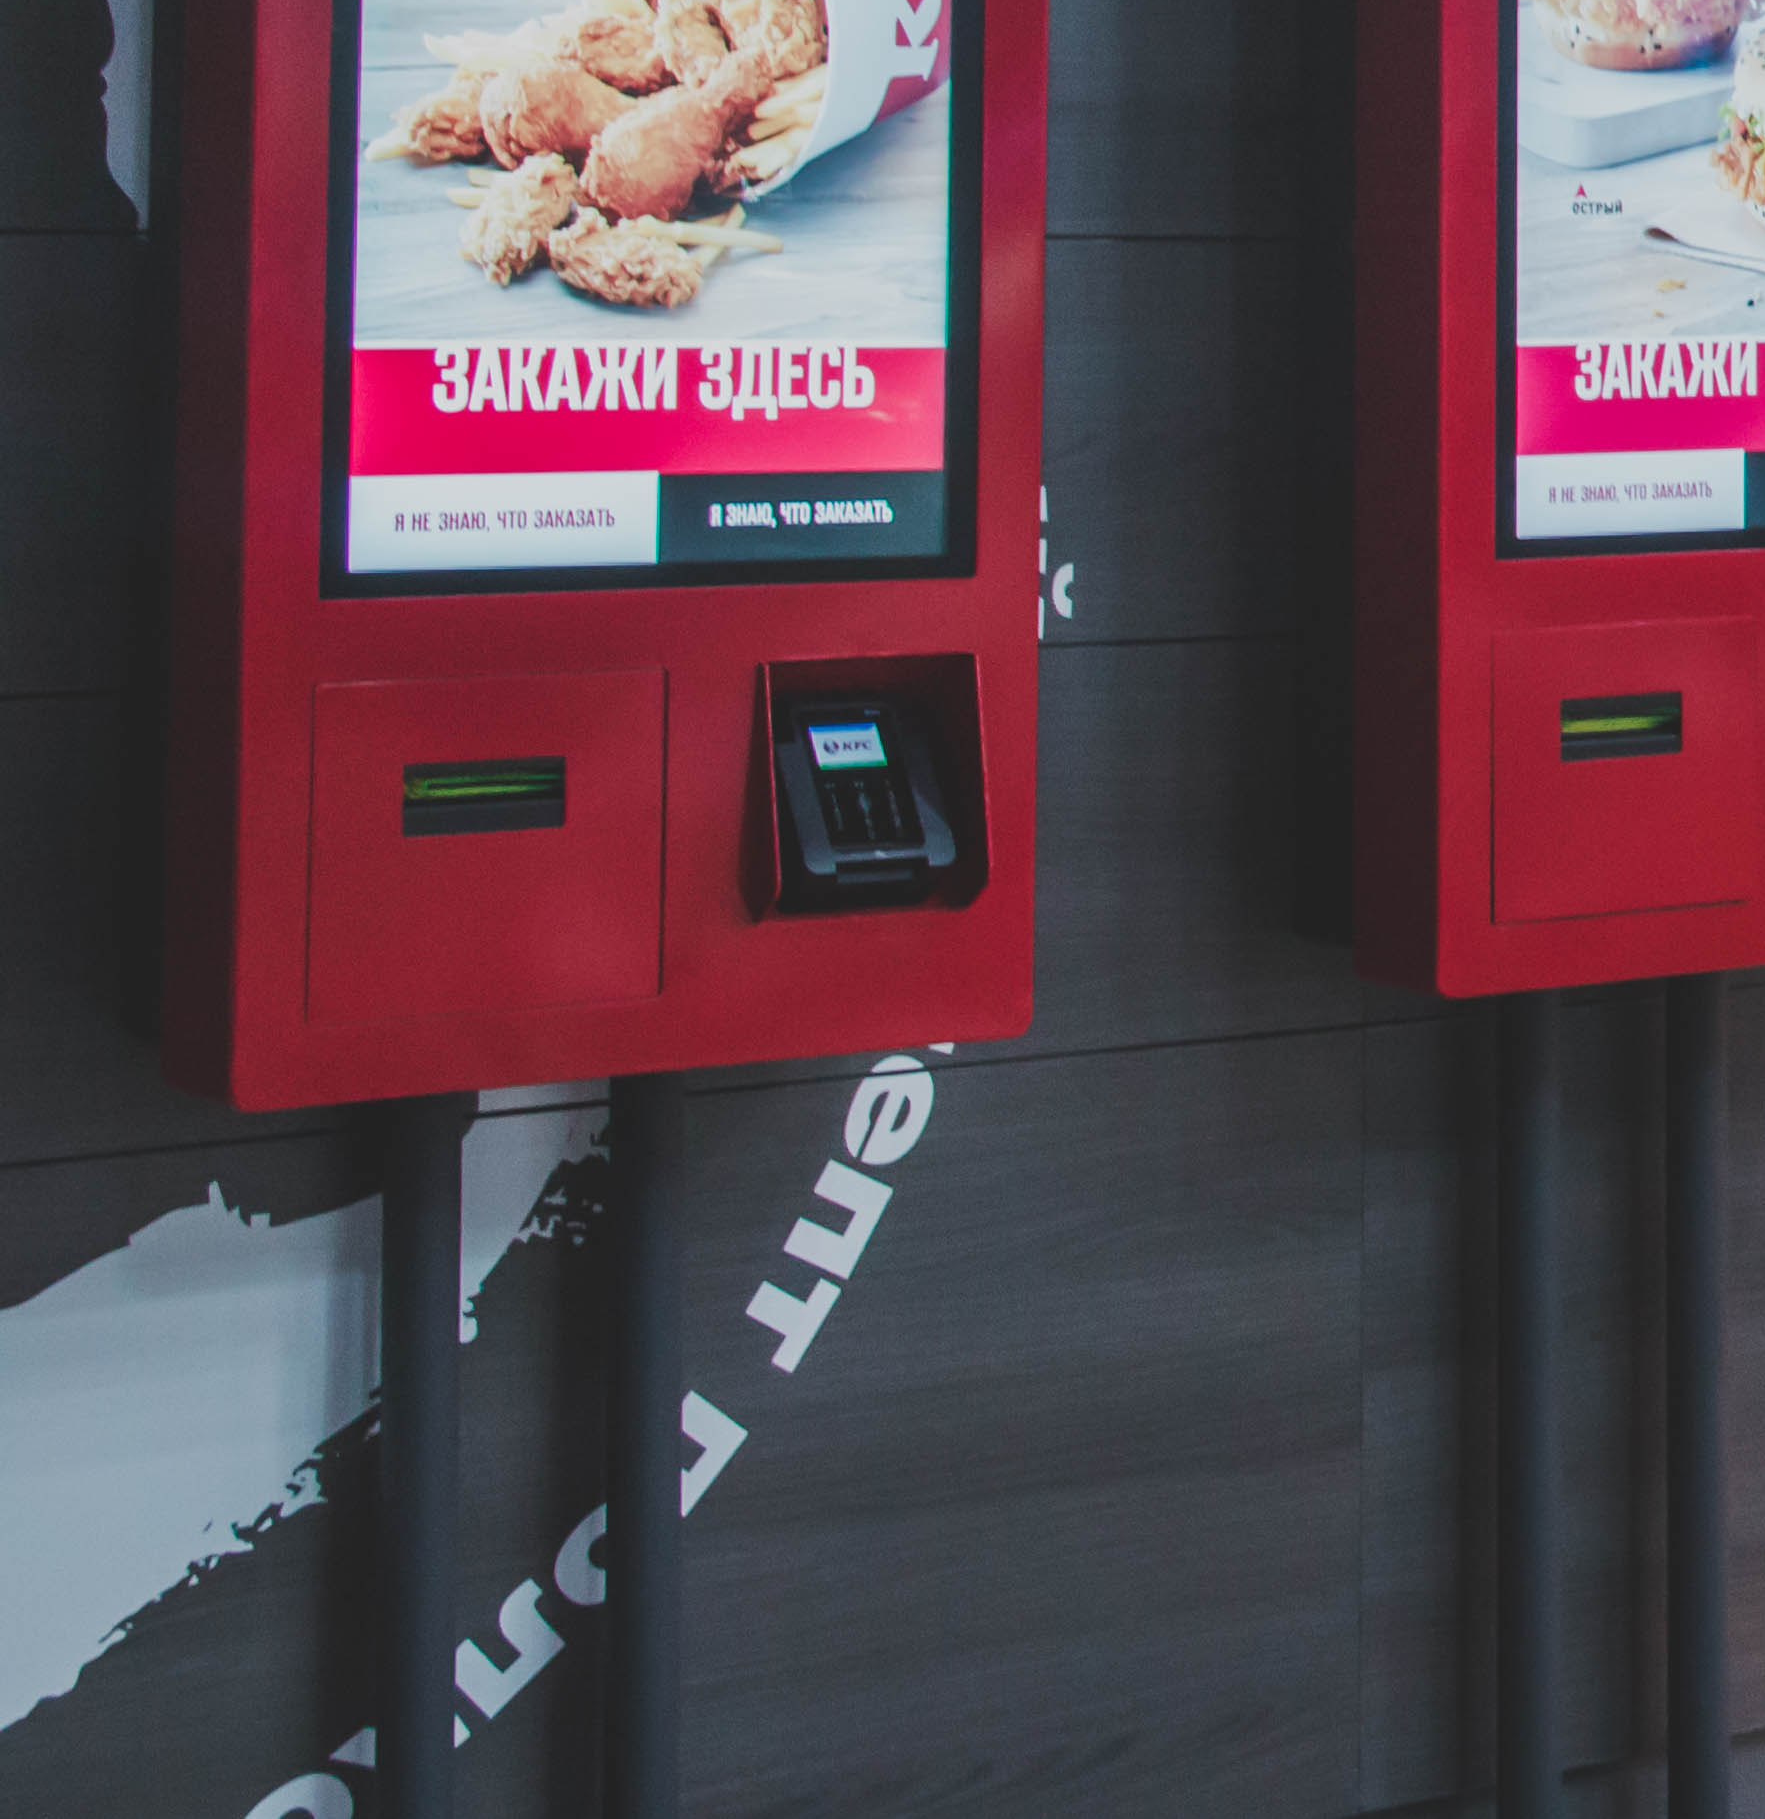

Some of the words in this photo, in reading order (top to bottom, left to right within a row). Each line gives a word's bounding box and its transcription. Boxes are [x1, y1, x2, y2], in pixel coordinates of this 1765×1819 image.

[1571, 200, 1624, 216] ОСТРЫЙ
[432, 346, 678, 414] ЗАКАЖИ
[698, 344, 875, 421] ЗДЕСЬ
[1574, 340, 1758, 401] ЗАКАЖИ
[1548, 486, 1557, 504] Я
[1561, 486, 1576, 503] НЕ
[1624, 483, 1648, 502] ЧТО
[1651, 480, 1713, 501] ЗАКАЗАТЬ
[394, 513, 405, 533] Я
[412, 513, 433, 532] НЕ
[438, 511, 490, 534] ЗНАЮ,
[497, 510, 528, 531] ЧТО
[533, 508, 616, 530] ЗАКАЗАТЬ
[708, 503, 722, 527] Я
[780, 502, 811, 525] ЧТО
[814, 499, 894, 526] ЗАКАЗАТЬ
[842, 739, 873, 752] KFC
[746, 1043, 954, 1373] епт
